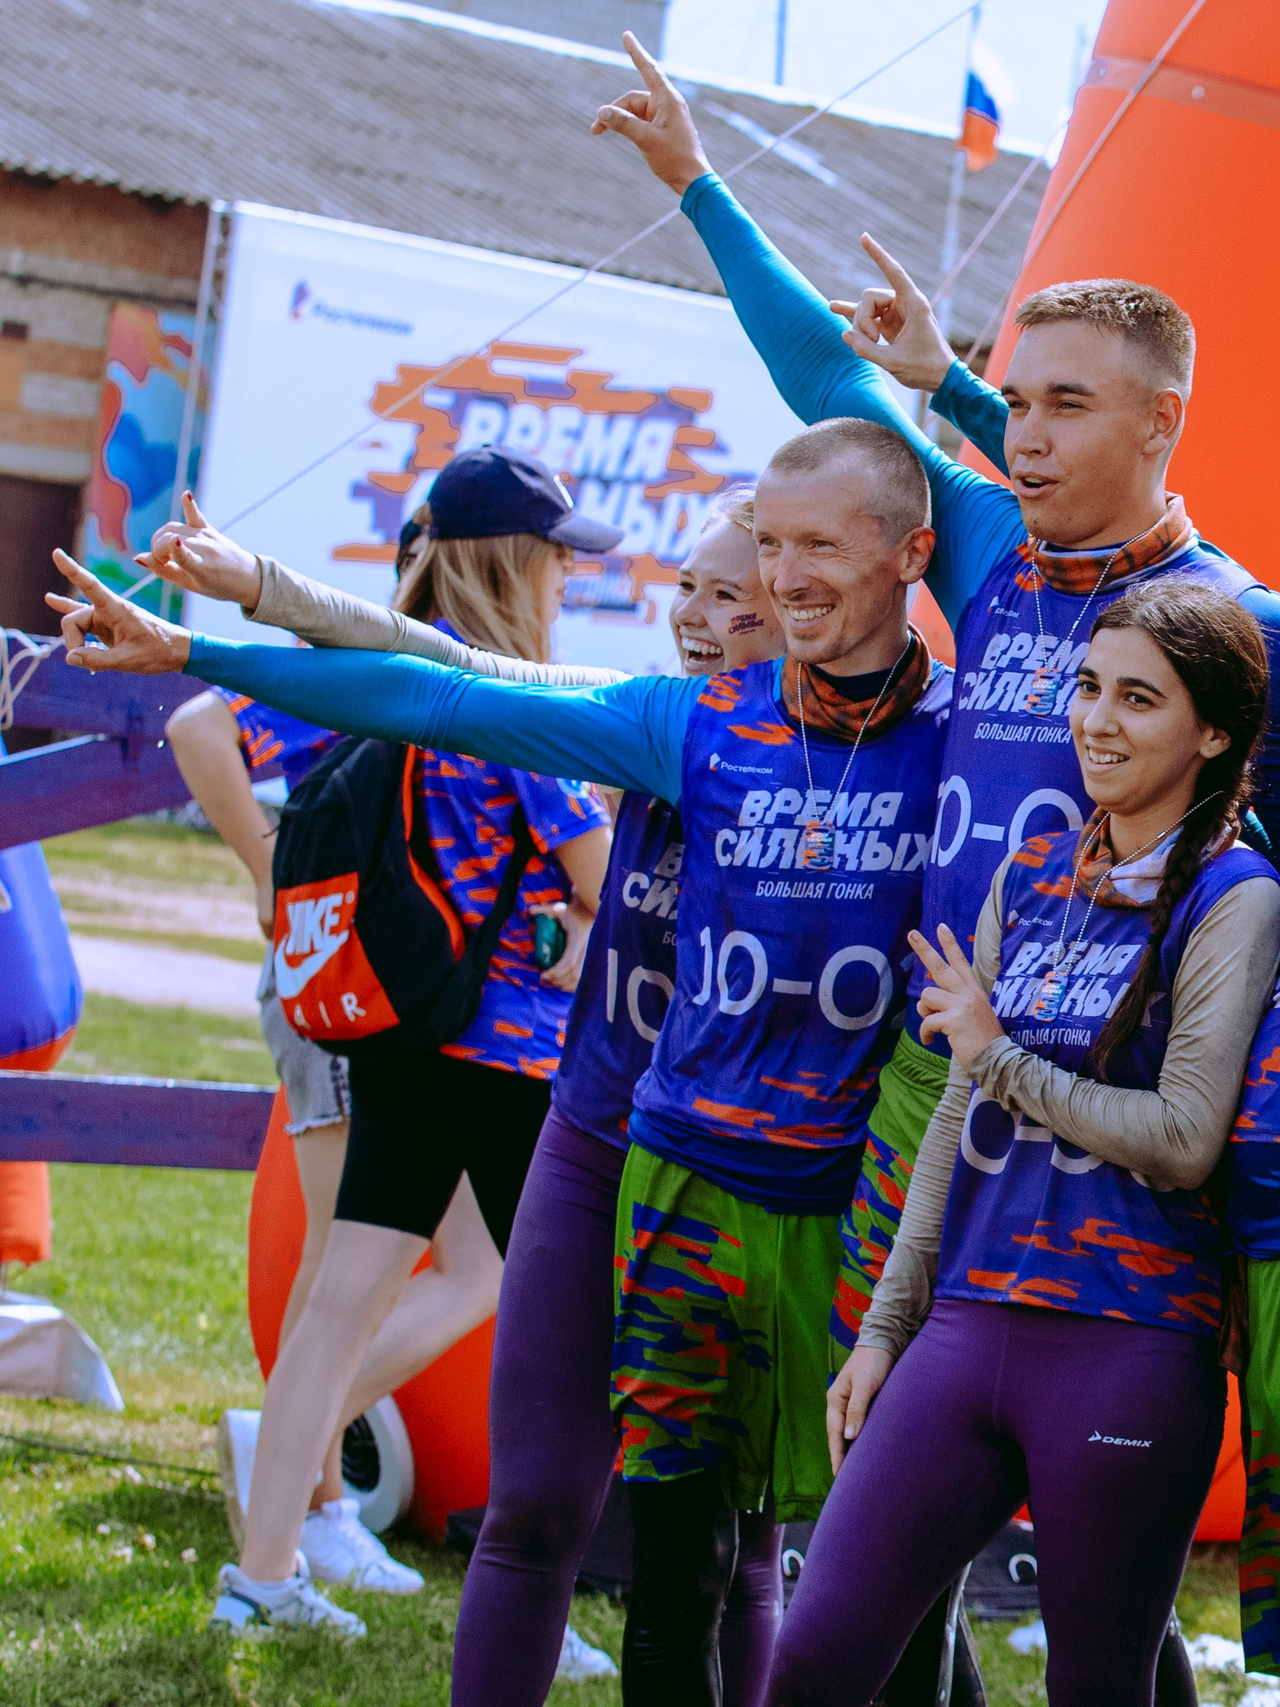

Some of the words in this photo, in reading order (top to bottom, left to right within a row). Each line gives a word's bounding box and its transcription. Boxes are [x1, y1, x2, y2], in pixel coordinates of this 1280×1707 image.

[459, 401, 677, 480] ВРЕМЯ
[980, 632, 1092, 674] ВРЕМ
[974, 722, 1032, 742] БОЛЬШАЯ
[1031, 725, 1072, 744] ГОНКА
[720, 761, 773, 775] Ростелеком
[738, 787, 904, 827] ВРЕМЯ
[756, 880, 823, 898] БОЛЬШАЯ
[826, 883, 875, 900] ГОНКА
[1005, 939, 1142, 977] ВРЕМЯ
[1057, 1028, 1092, 1047] ГОНКА
[1101, 1436, 1153, 1447] DEMIX
